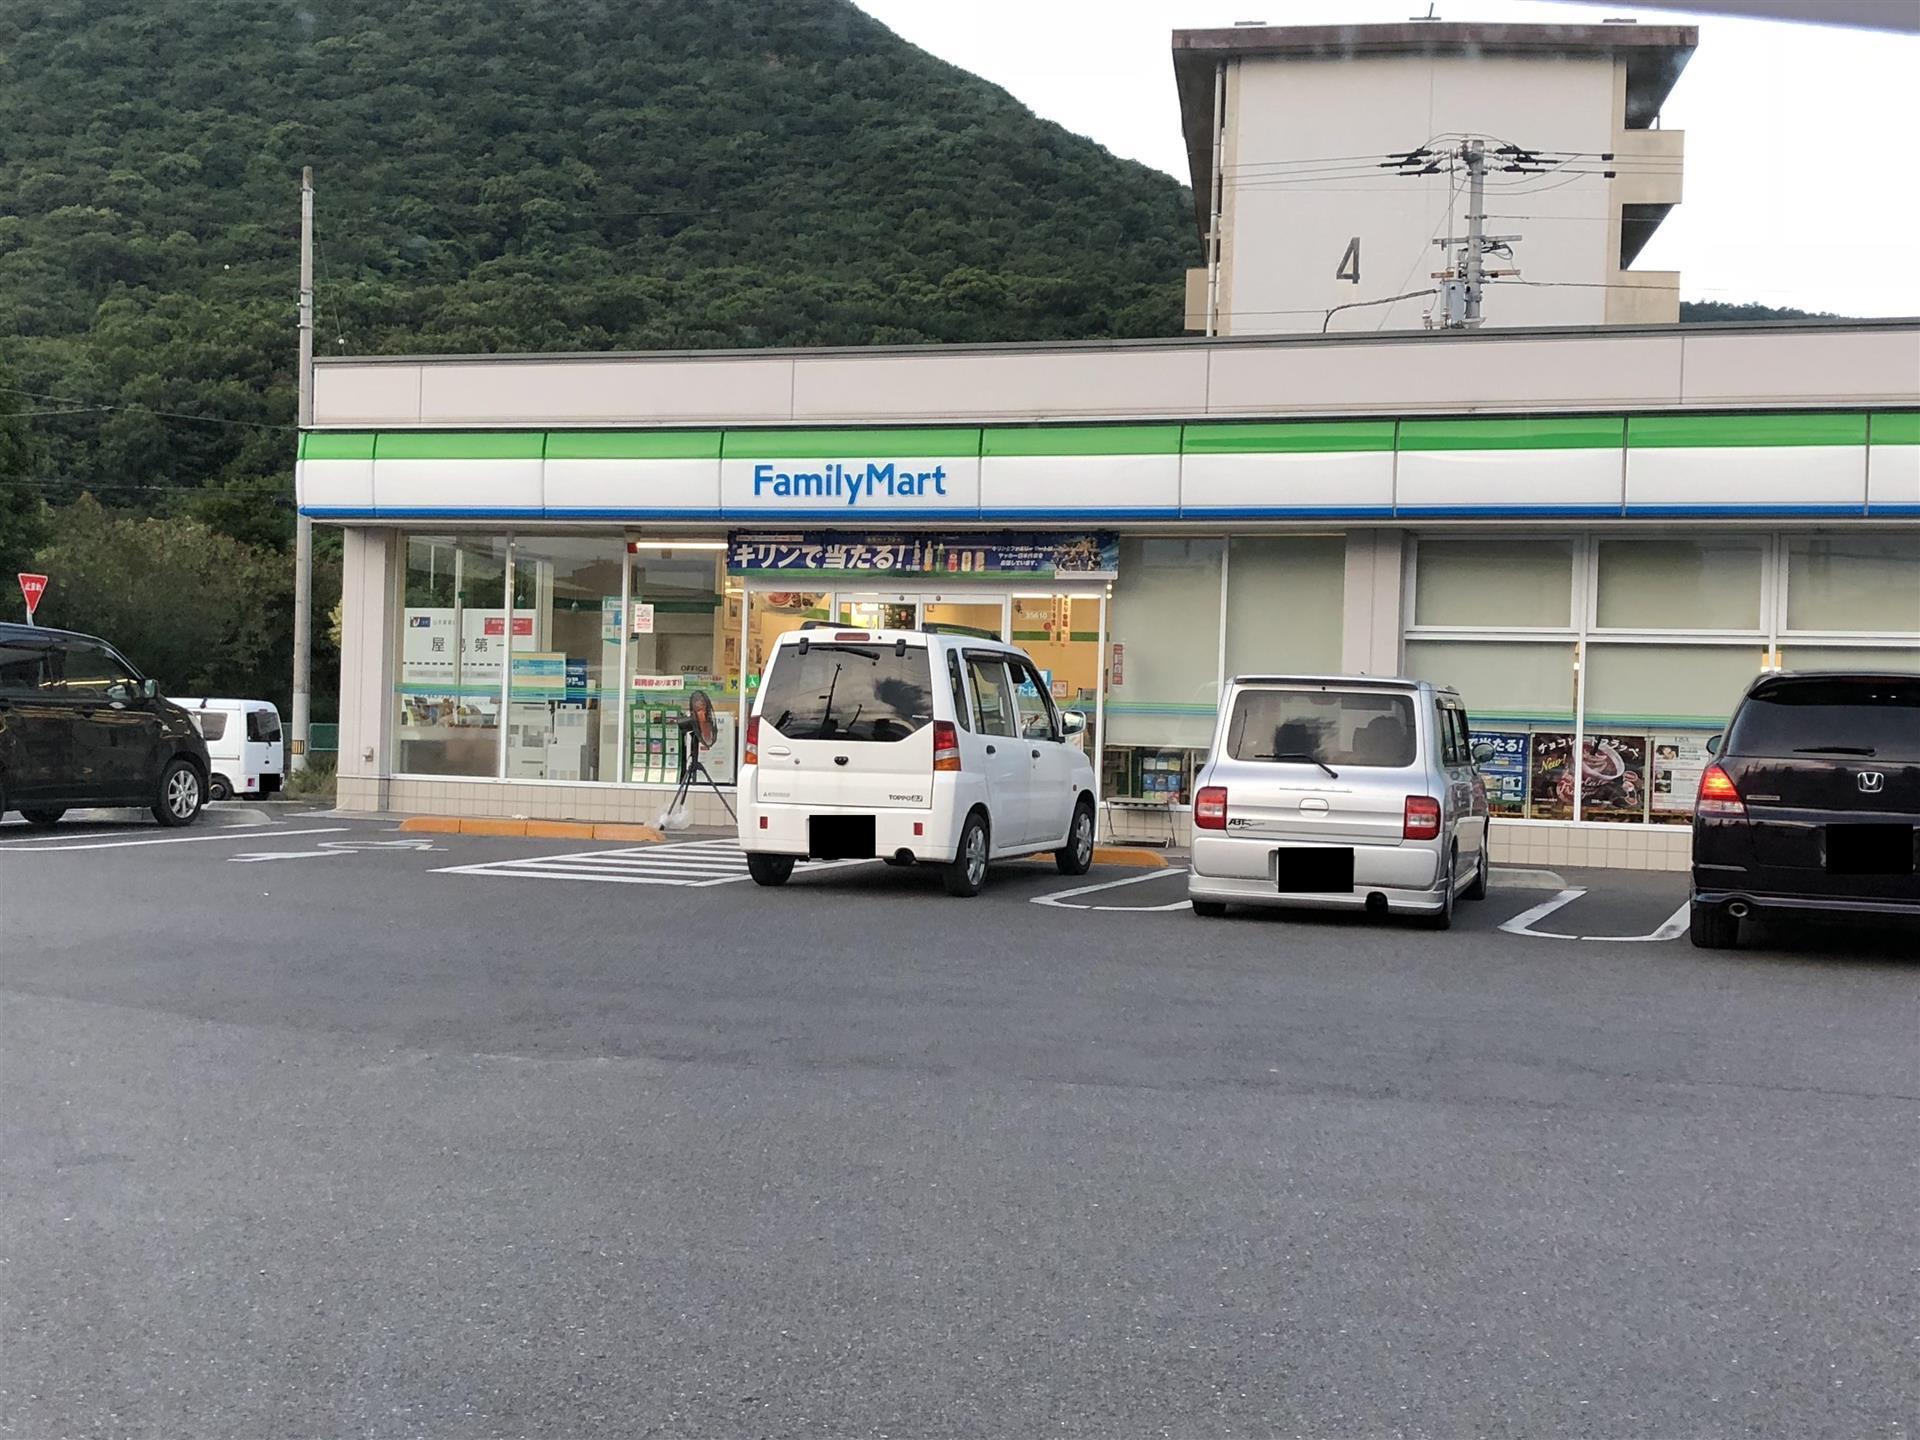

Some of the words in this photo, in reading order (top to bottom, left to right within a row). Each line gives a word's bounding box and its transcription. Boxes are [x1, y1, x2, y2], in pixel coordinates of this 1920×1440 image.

[1336, 236, 1361, 284] 4
[753, 463, 947, 505] FamilyMart
[734, 543, 905, 569] キリンで当たる!
[680, 664, 709, 673] OFFICE
